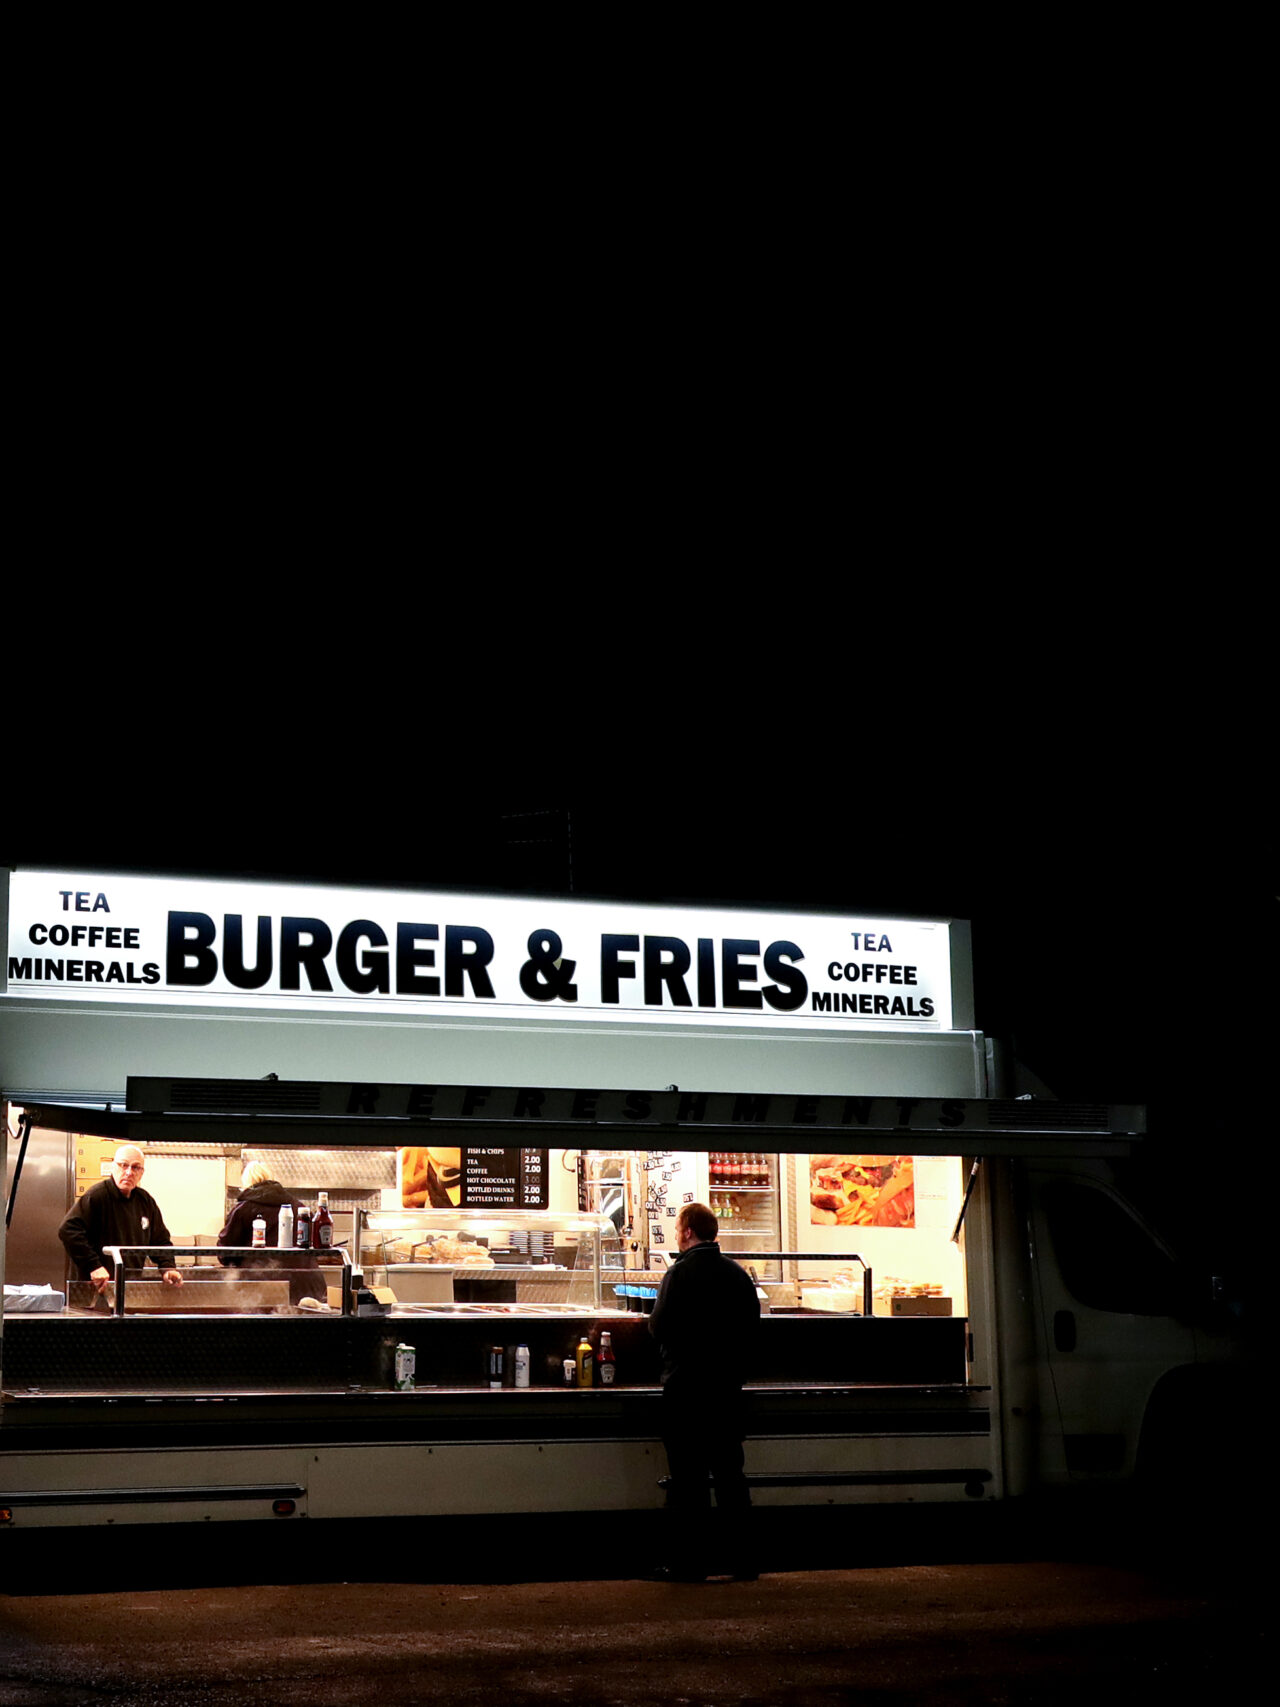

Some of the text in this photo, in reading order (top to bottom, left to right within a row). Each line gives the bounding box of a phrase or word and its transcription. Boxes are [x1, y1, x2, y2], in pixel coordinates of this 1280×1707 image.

[59, 891, 111, 913] TEA
[28, 923, 140, 950] COFFEE
[850, 932, 893, 953] TEA
[7, 956, 161, 985] MINERALS
[166, 910, 809, 1012] BURGER & FRIES
[827, 961, 918, 986] COFFEE
[811, 991, 935, 1017] MINERALS
[347, 1083, 966, 1126] REFRESHMENTS
[524, 1156, 541, 1164] 2.00
[525, 1165, 541, 1173] 2.00
[524, 1186, 540, 1194] 2.00
[524, 1196, 540, 1204] 2.00
